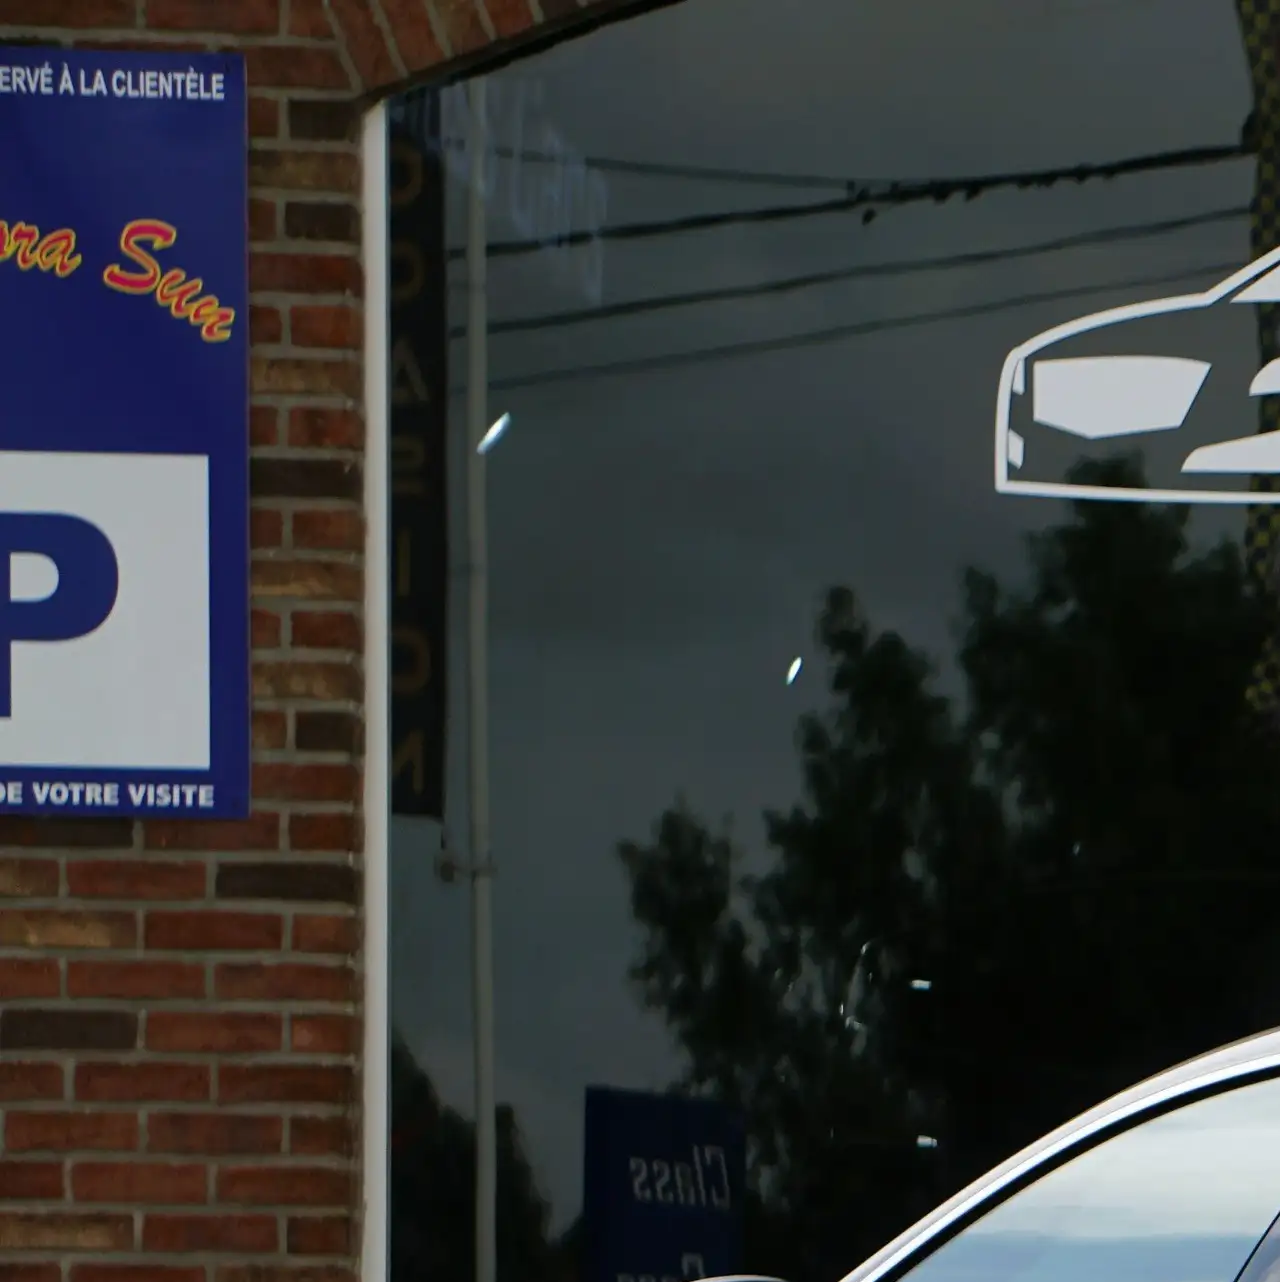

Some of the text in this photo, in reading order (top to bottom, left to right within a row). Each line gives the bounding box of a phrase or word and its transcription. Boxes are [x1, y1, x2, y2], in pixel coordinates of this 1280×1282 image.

[59, 63, 75, 96] À
[80, 69, 108, 97] LA
[111, 66, 225, 101] CLIENTÈLE
[103, 218, 235, 342] Sun
[0, 511, 119, 719] P
[32, 782, 120, 807] VOTRE
[128, 784, 215, 808] VISITE
